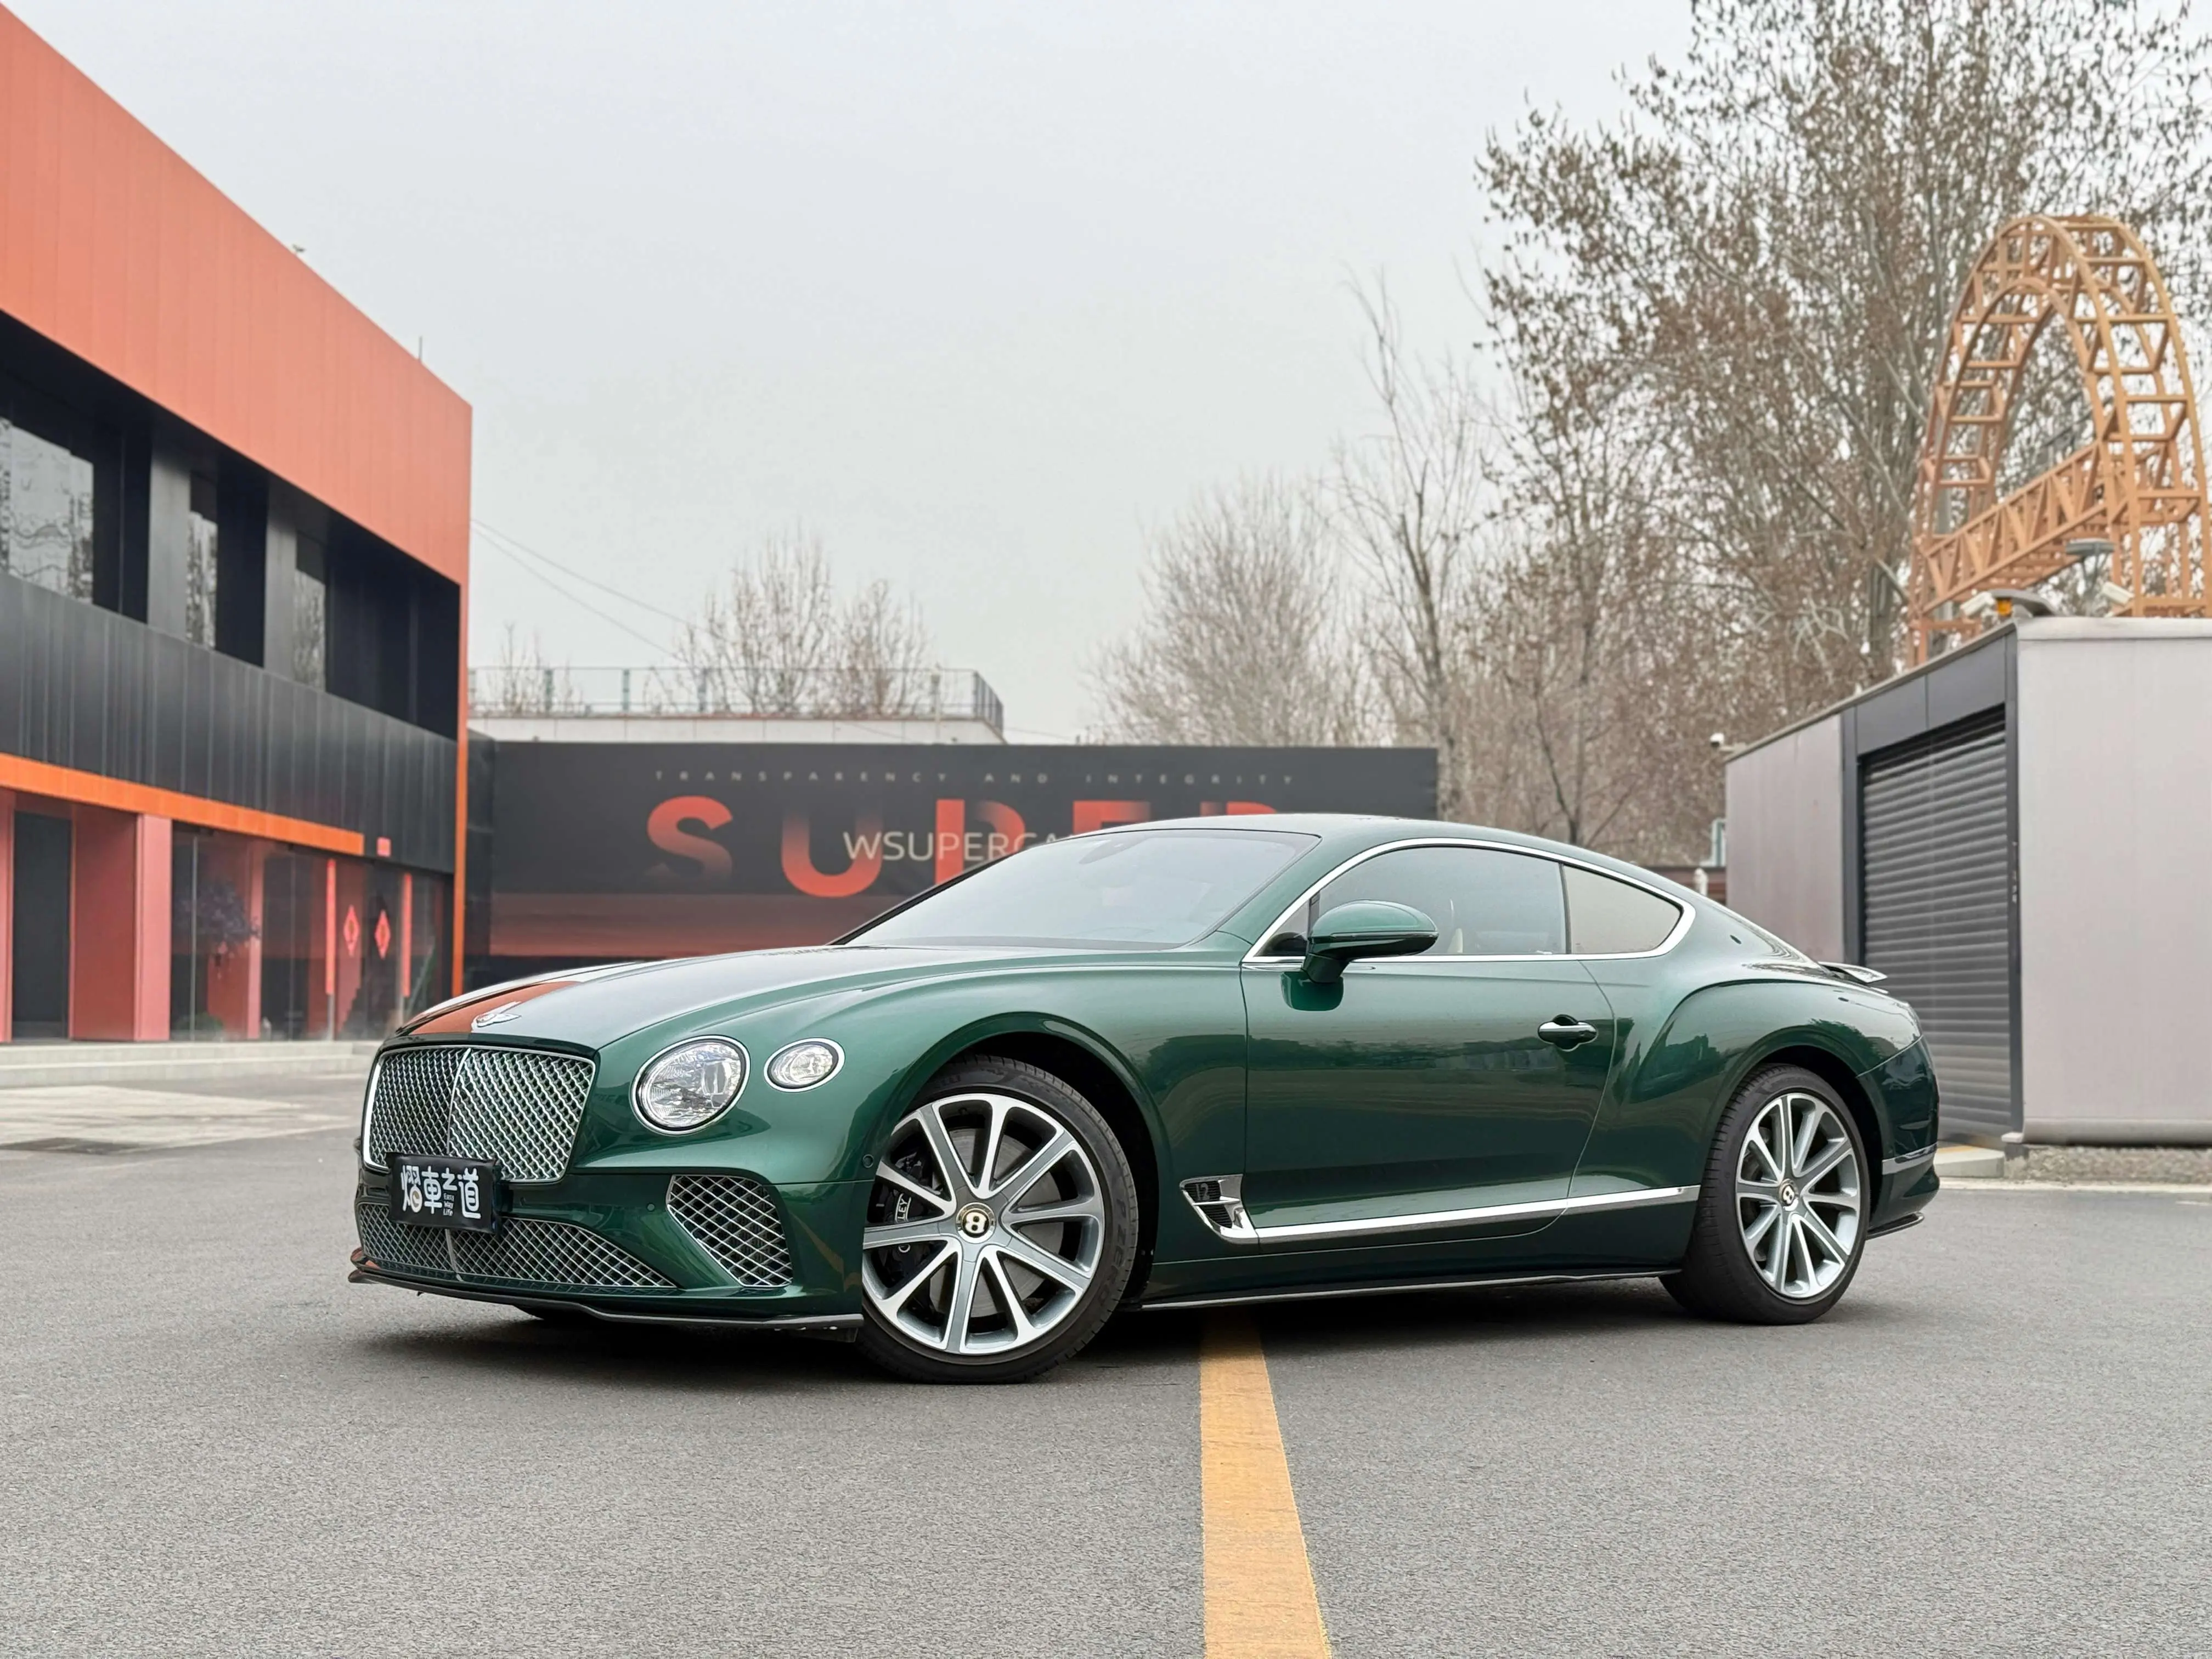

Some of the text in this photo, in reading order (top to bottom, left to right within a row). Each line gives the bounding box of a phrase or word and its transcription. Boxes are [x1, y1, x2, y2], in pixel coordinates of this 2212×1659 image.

[656, 771, 1293, 785] TRANSPARENCY AND INTEGRITY
[645, 795, 1277, 898] SUP
[1195, 1183, 1210, 1201] 12
